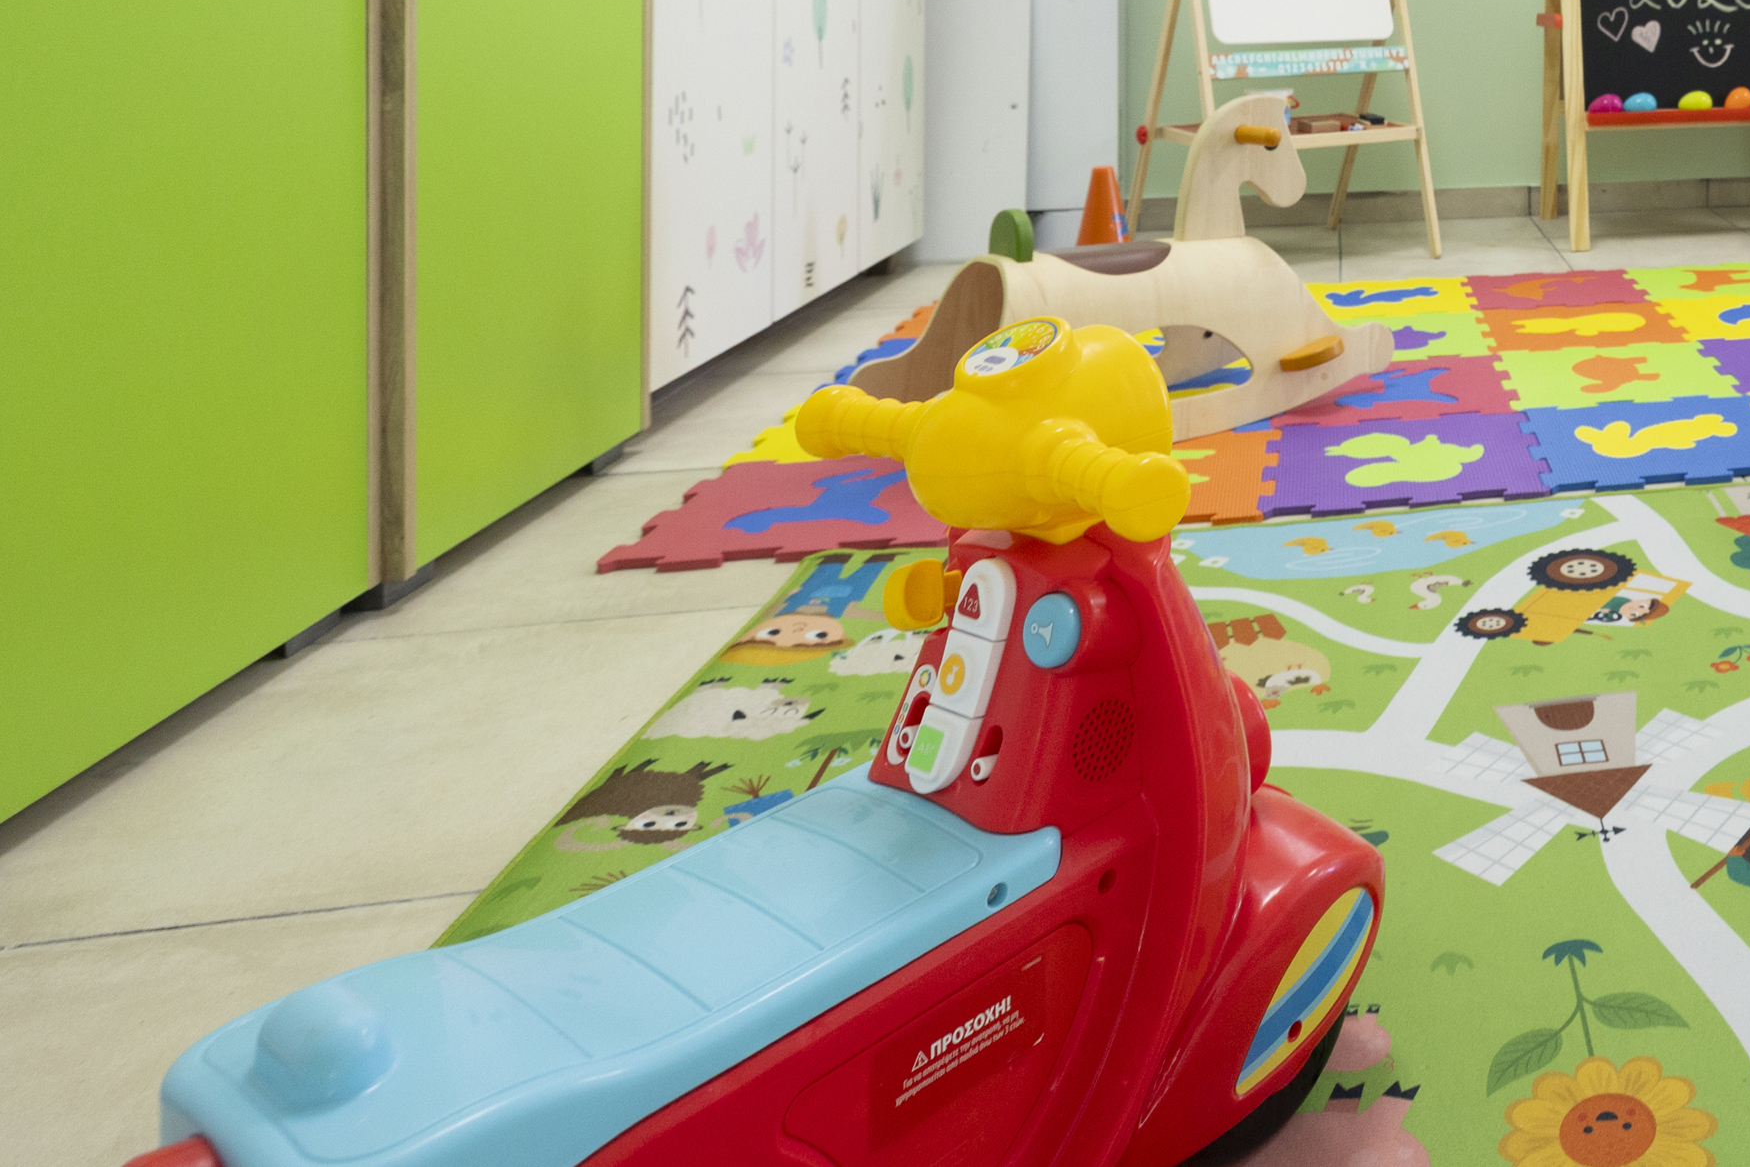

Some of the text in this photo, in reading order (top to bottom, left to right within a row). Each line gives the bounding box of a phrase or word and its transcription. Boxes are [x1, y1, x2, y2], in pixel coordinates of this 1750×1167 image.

[961, 595, 980, 613] 123
[917, 742, 936, 756] ABC
[930, 995, 1012, 1060] ΠΡΟΣΟΧΗ!
